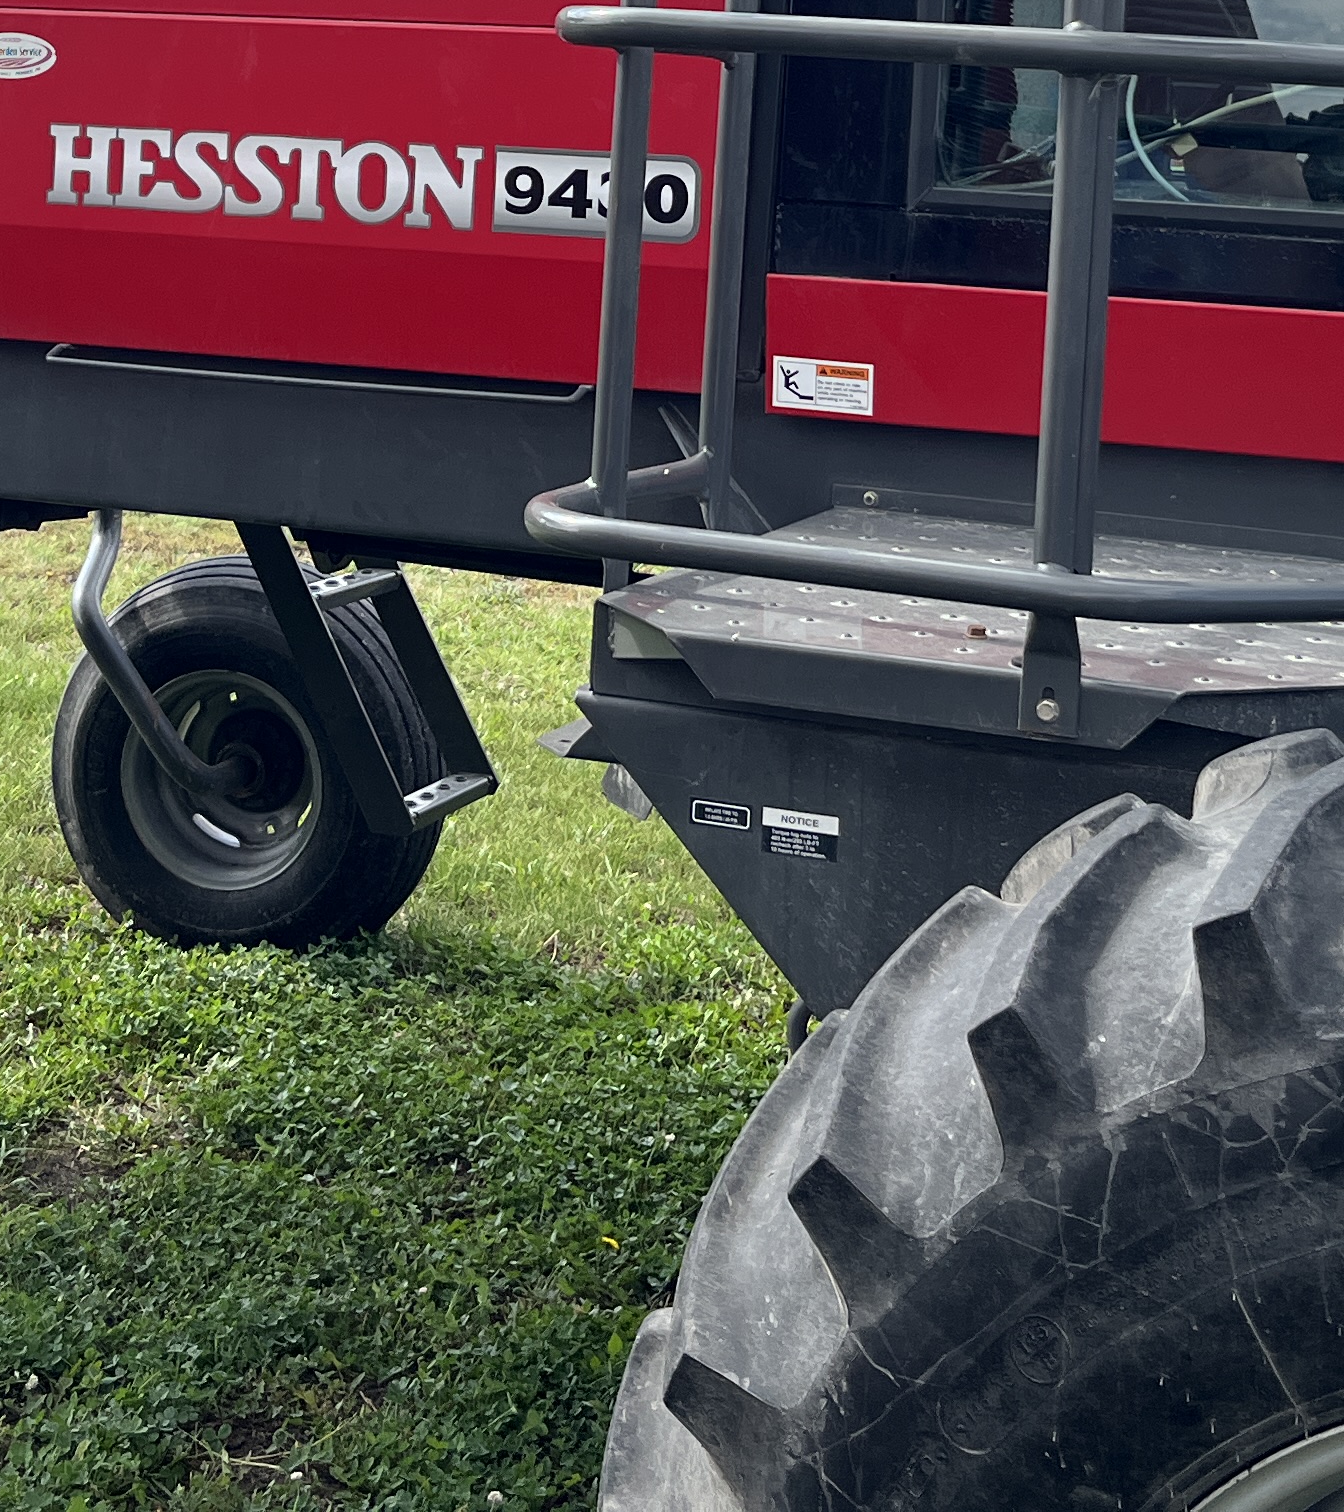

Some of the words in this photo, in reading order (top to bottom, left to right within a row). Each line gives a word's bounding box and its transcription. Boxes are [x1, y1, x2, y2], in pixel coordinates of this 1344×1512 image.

[19, 47, 42, 57] Service
[46, 122, 485, 231] HESSTON
[504, 165, 689, 224] 940
[830, 369, 865, 377] WARNING
[781, 815, 819, 828] NOTICE
